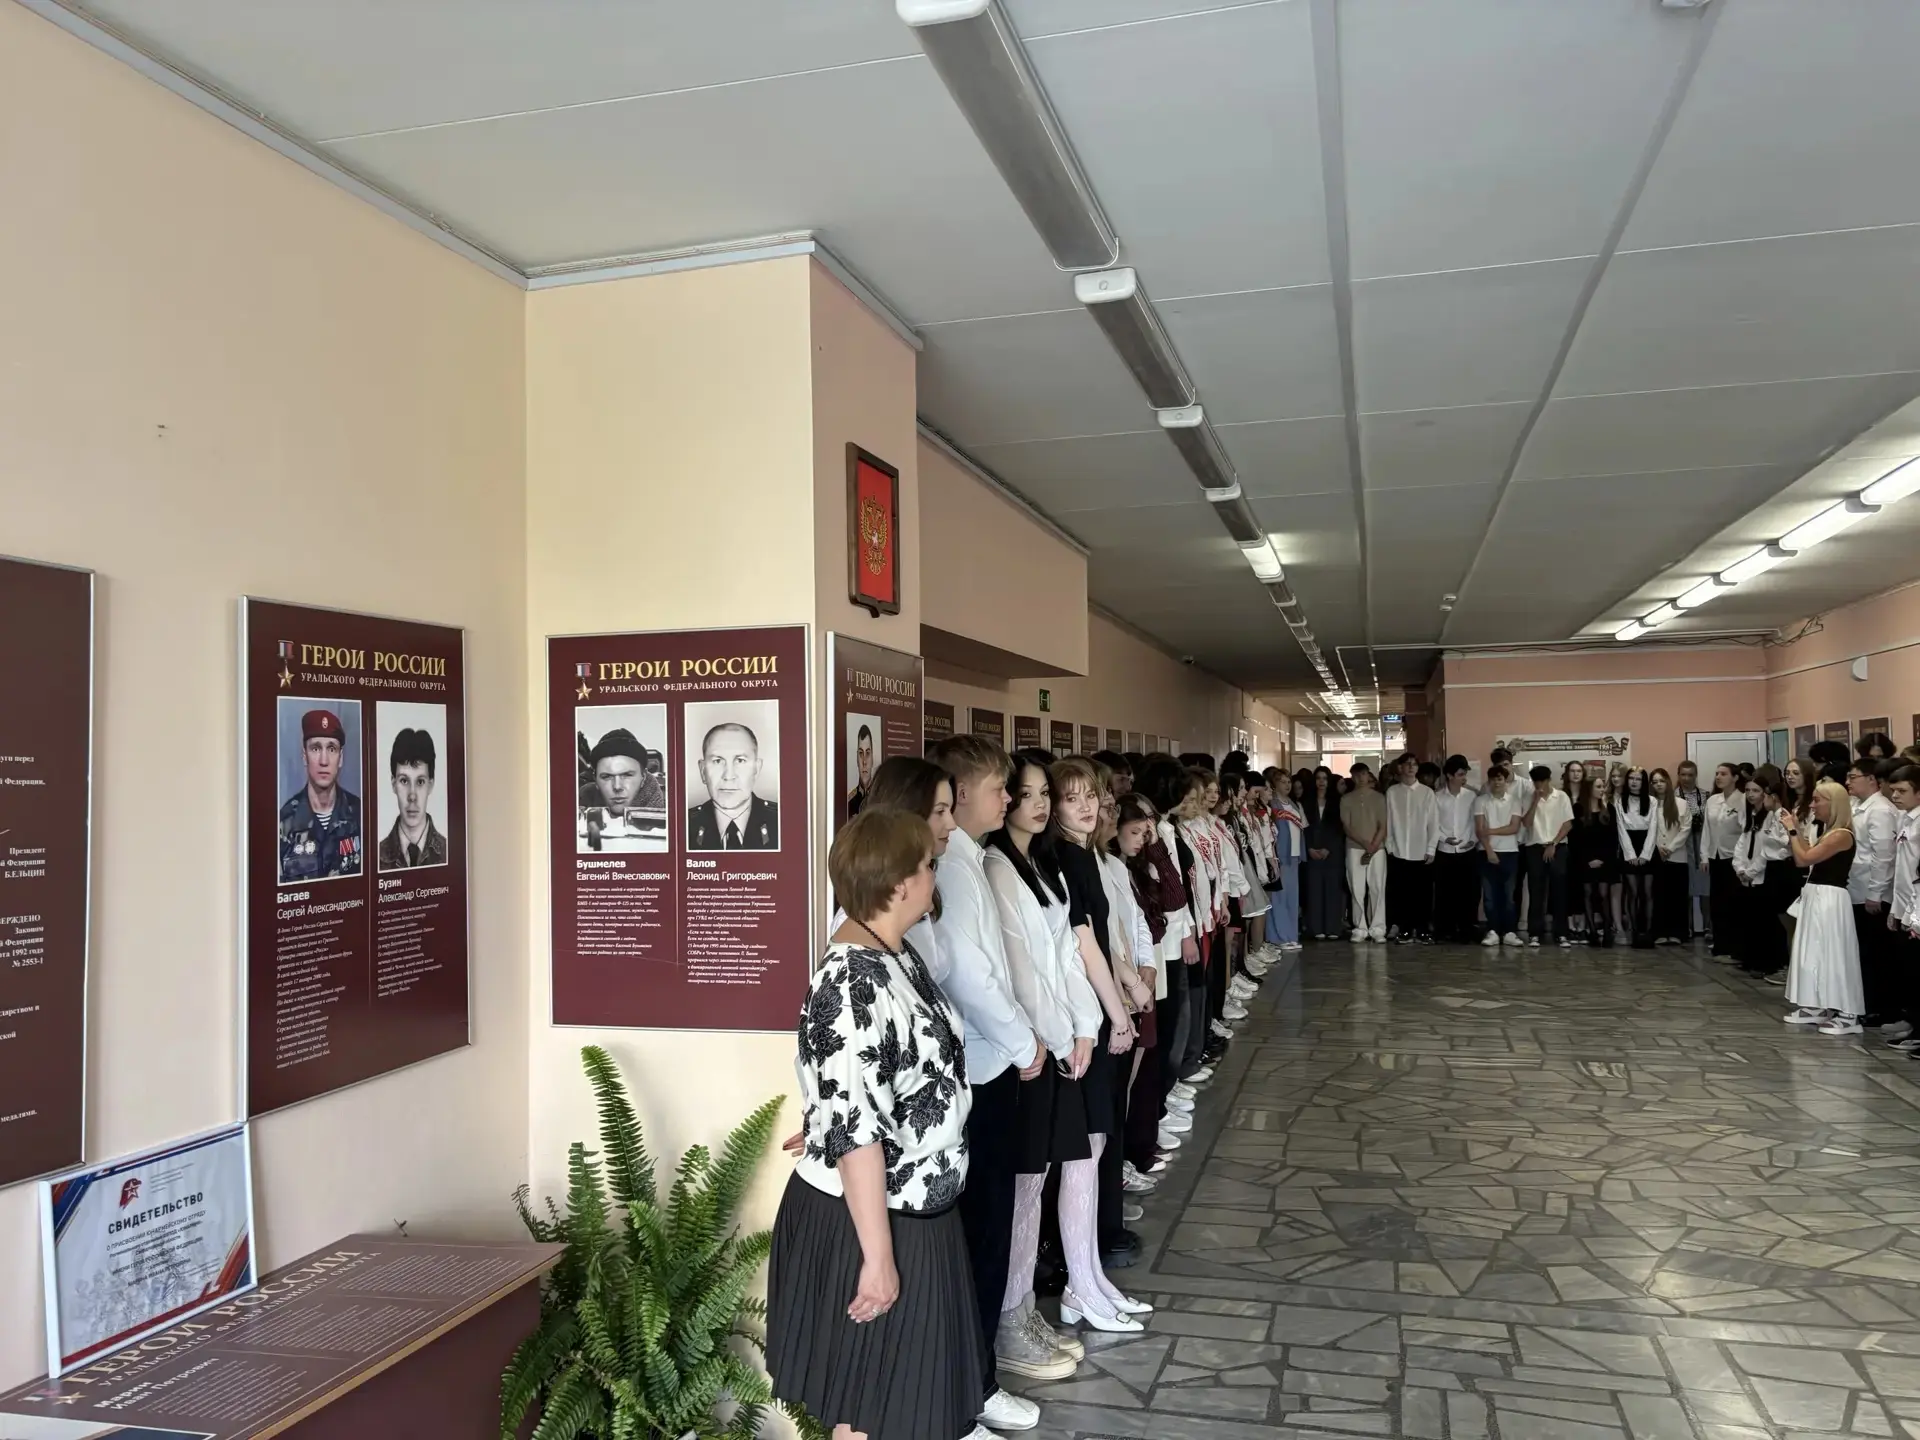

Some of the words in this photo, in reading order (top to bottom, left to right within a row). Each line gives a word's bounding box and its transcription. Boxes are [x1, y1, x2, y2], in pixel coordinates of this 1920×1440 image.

[301, 644, 365, 670] ГЕРОИ
[374, 652, 446, 676] РОССИИ
[599, 660, 670, 680] ГЕРОИ
[680, 656, 778, 677] РОССИИ
[301, 672, 355, 684] УРАЛЬСКОГО
[358, 677, 417, 688] ФЕДЕРАЛЬНОГО
[420, 682, 446, 690] ОКРУГА
[600, 684, 658, 694] УРАЛЬСКОГО
[664, 681, 737, 692] ФЕДЕРАЛЬНОГО
[742, 680, 778, 688] ОКРУГА
[856, 671, 882, 692] ГЕРОИ
[885, 678, 916, 697] РОССИИ
[576, 860, 626, 870] Бушмелев
[686, 859, 716, 868] Валов
[378, 879, 402, 890] Бузин
[576, 872, 610, 880] Евгений
[612, 872, 670, 880] Вячеславович
[686, 872, 719, 881] Леонид
[722, 872, 777, 882] Григорьевич
[277, 892, 310, 903] Багаев
[378, 891, 414, 903] Александр
[416, 886, 449, 898] Сергеевич
[277, 905, 306, 920] Сергей
[307, 899, 364, 916] Александрович
[14, 926, 44, 934] Законом
[12, 948, 28, 956] 1992
[22, 957, 44, 966] 2553-1
[108, 1192, 203, 1234] СВИДЕТЕЛЬСТВО
[61, 1322, 212, 1384] ГЕРОИ
[209, 1251, 362, 1316] РОССИИ
[98, 1334, 211, 1387] УРАЛЬСКОГО
[216, 1278, 327, 1332] ФЕДЕРАЛЬНОГО
[330, 1252, 382, 1276] ОКРУГА
[110, 1391, 152, 1410] Иван
[150, 1358, 220, 1390] Петрович
[93, 1382, 152, 1408] Марин
